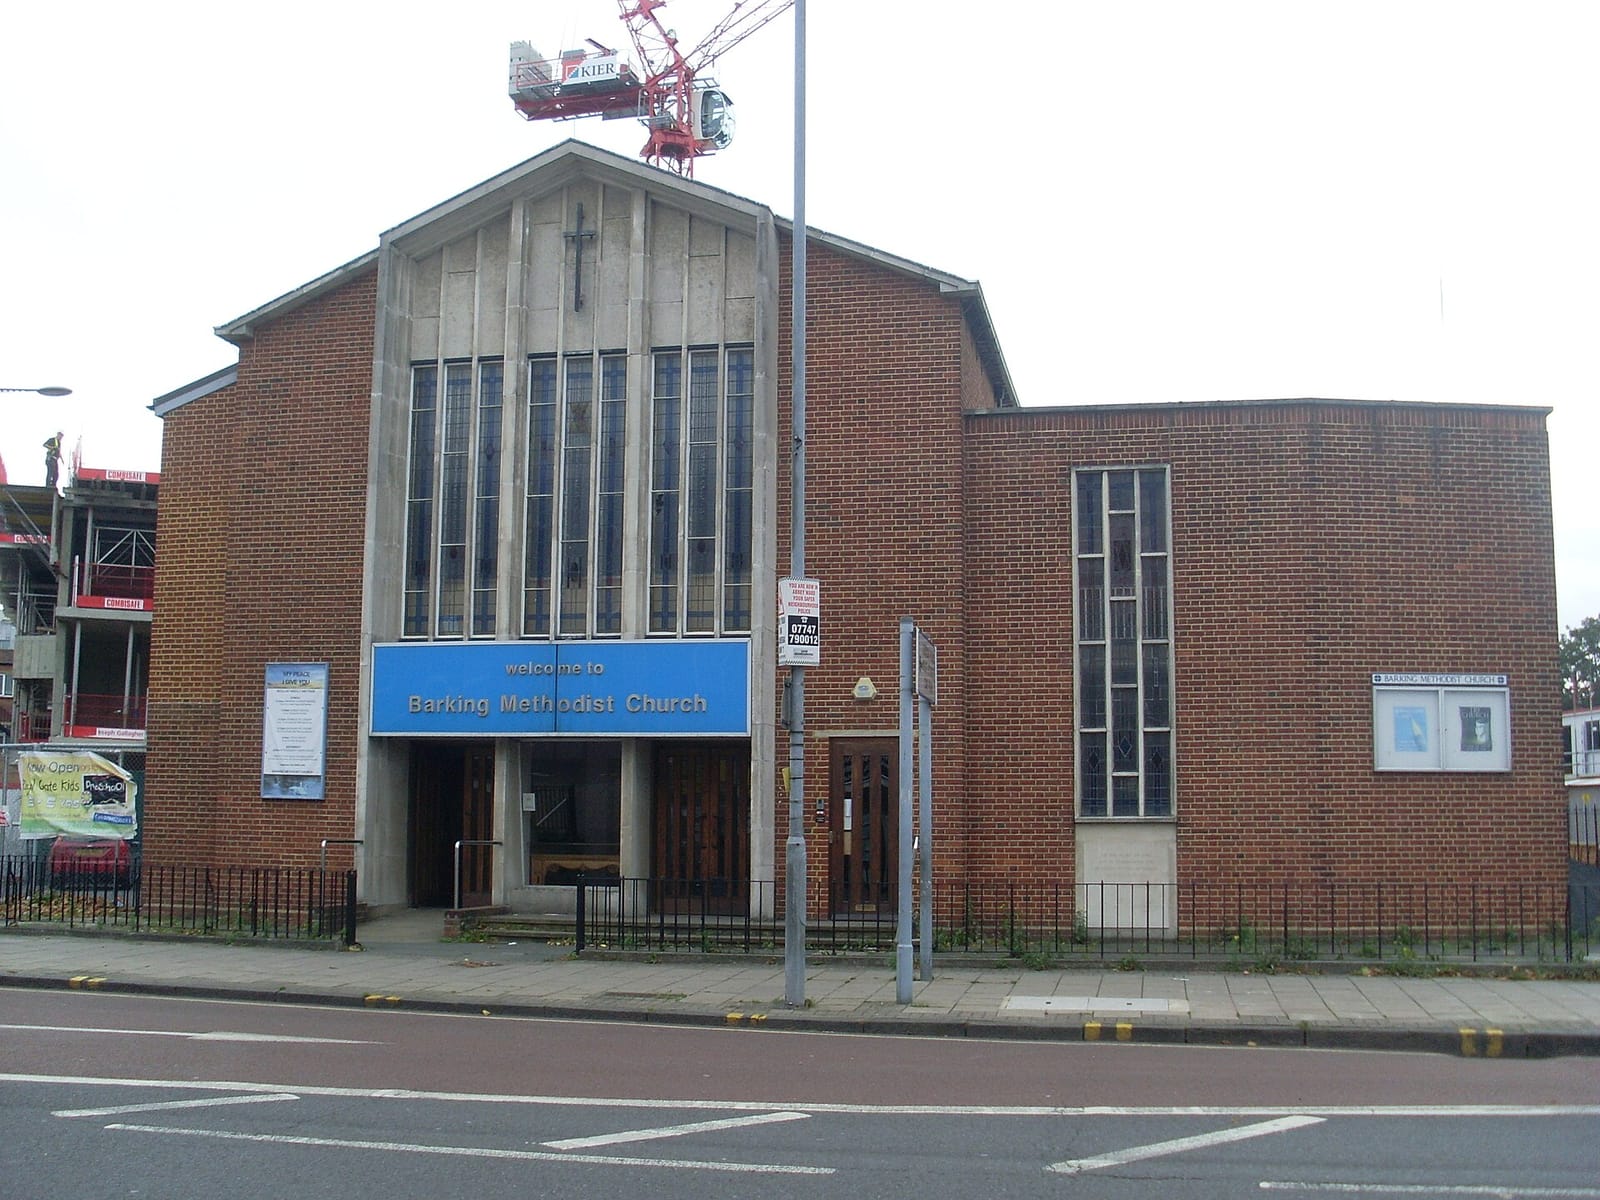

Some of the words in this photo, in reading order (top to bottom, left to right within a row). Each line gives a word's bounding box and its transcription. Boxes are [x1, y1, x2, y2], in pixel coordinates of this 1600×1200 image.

[581, 63, 615, 78] KIER
[106, 599, 140, 608] COMBISAFE
[791, 624, 816, 634] 07747
[789, 635, 818, 644] 790012
[505, 661, 581, 676] welcome
[586, 661, 604, 675] to
[1420, 675, 1461, 683] METHODIST
[408, 694, 490, 718] Barking
[500, 694, 614, 713] Methodist
[625, 693, 708, 713] Church
[48, 761, 80, 775] Open
[38, 779, 58, 792] Gate
[61, 779, 80, 792] Kids
